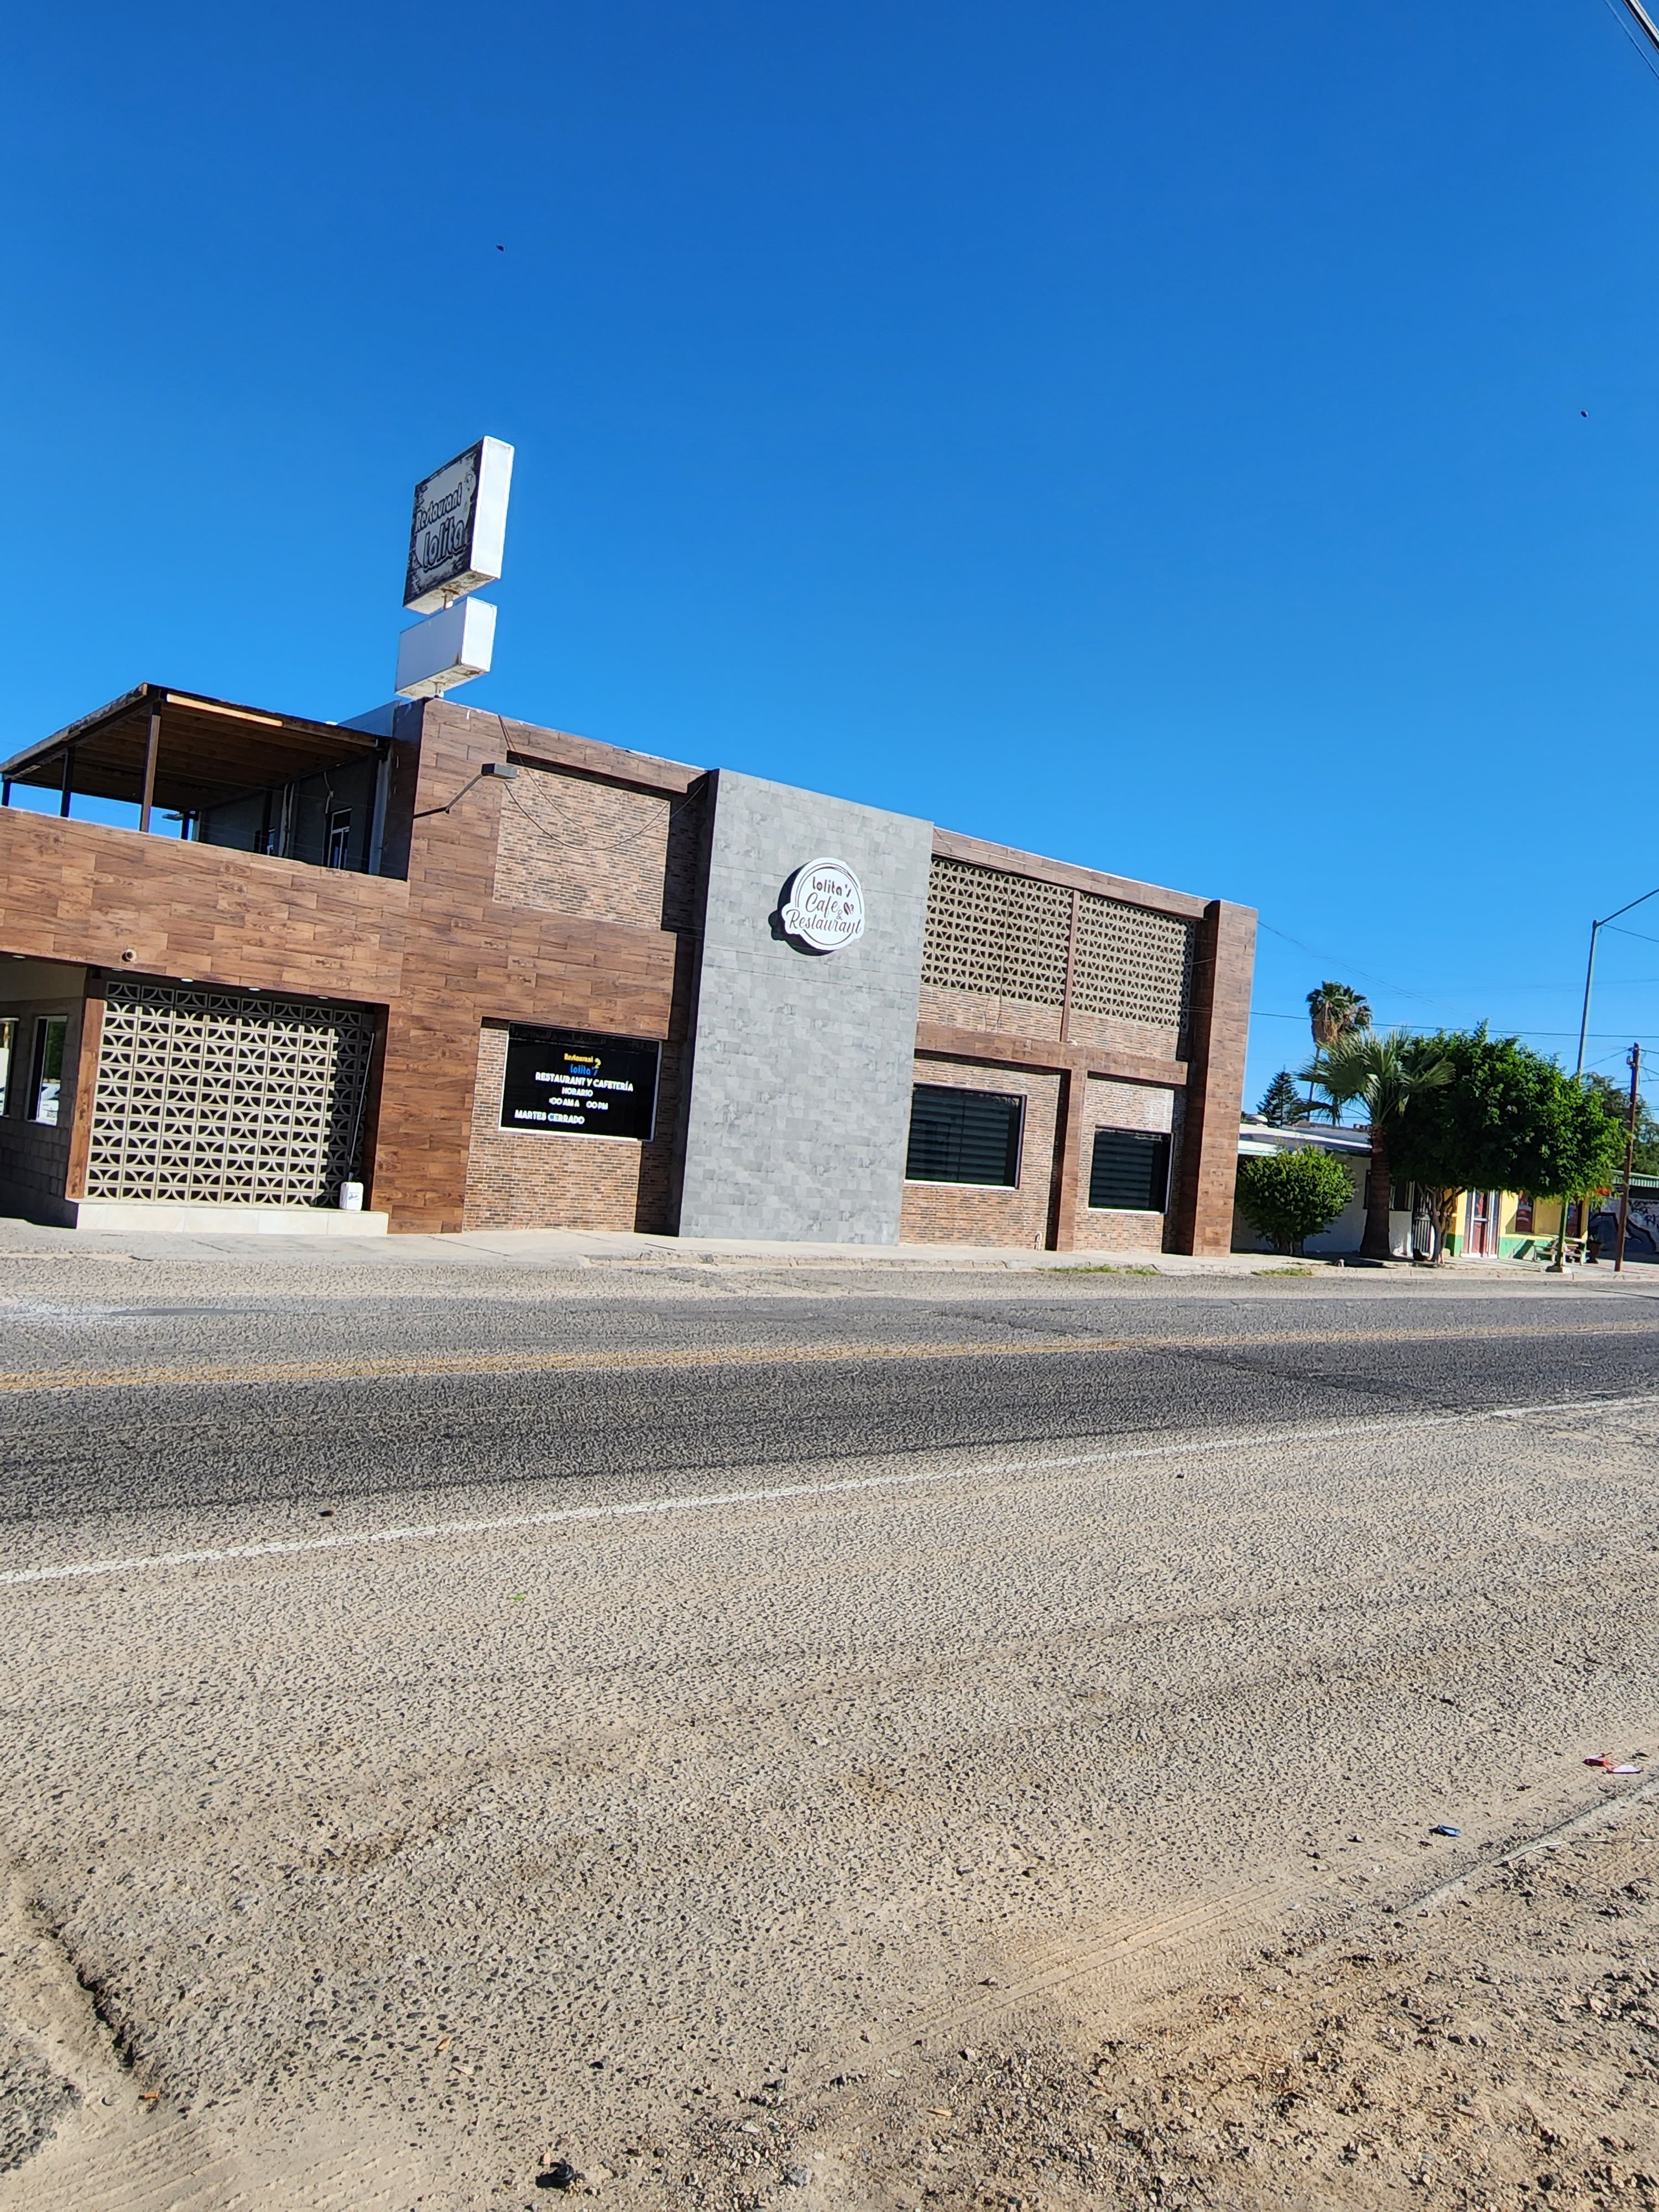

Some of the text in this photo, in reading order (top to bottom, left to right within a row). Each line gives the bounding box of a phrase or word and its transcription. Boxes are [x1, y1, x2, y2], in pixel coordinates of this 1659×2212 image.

[415, 482, 463, 534] Restaurant
[812, 876, 852, 898] lolita's
[786, 909, 862, 934] Restaurant
[535, 1072, 634, 1092] RESTAURANT Y CAFETERÍA
[562, 1087, 593, 1097] HORARIO
[562, 1098, 574, 1107] AM
[574, 1099, 580, 1107] A
[598, 1102, 608, 1110] PM
[514, 1109, 585, 1125] MARTES CERRADO
